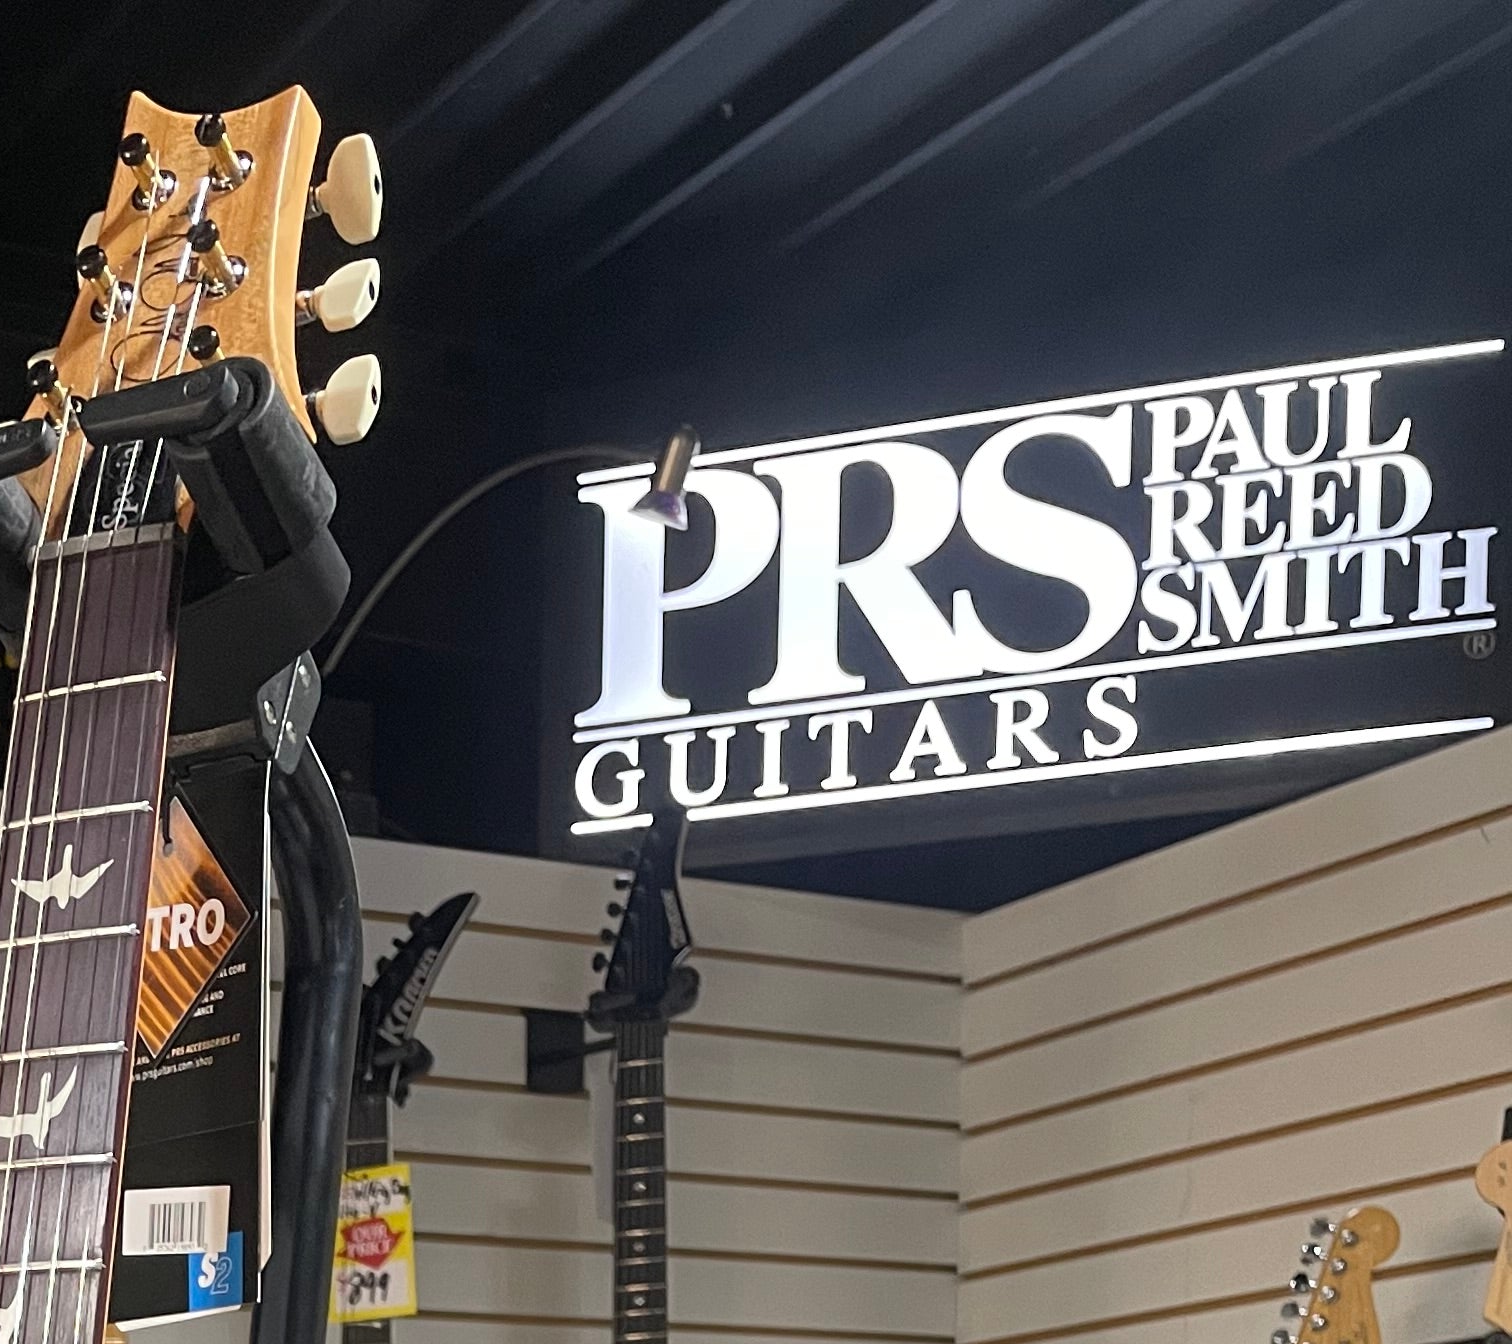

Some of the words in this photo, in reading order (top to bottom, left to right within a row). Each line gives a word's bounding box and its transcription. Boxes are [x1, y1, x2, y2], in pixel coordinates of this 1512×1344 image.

[1144, 371, 1412, 486] PAUL
[575, 403, 1139, 728] PRS
[1142, 452, 1434, 573] REED
[1137, 526, 1496, 656] SMITH
[574, 674, 1140, 819] GUITARS
[147, 898, 225, 953] TRO
[197, 1250, 233, 1295] S2
